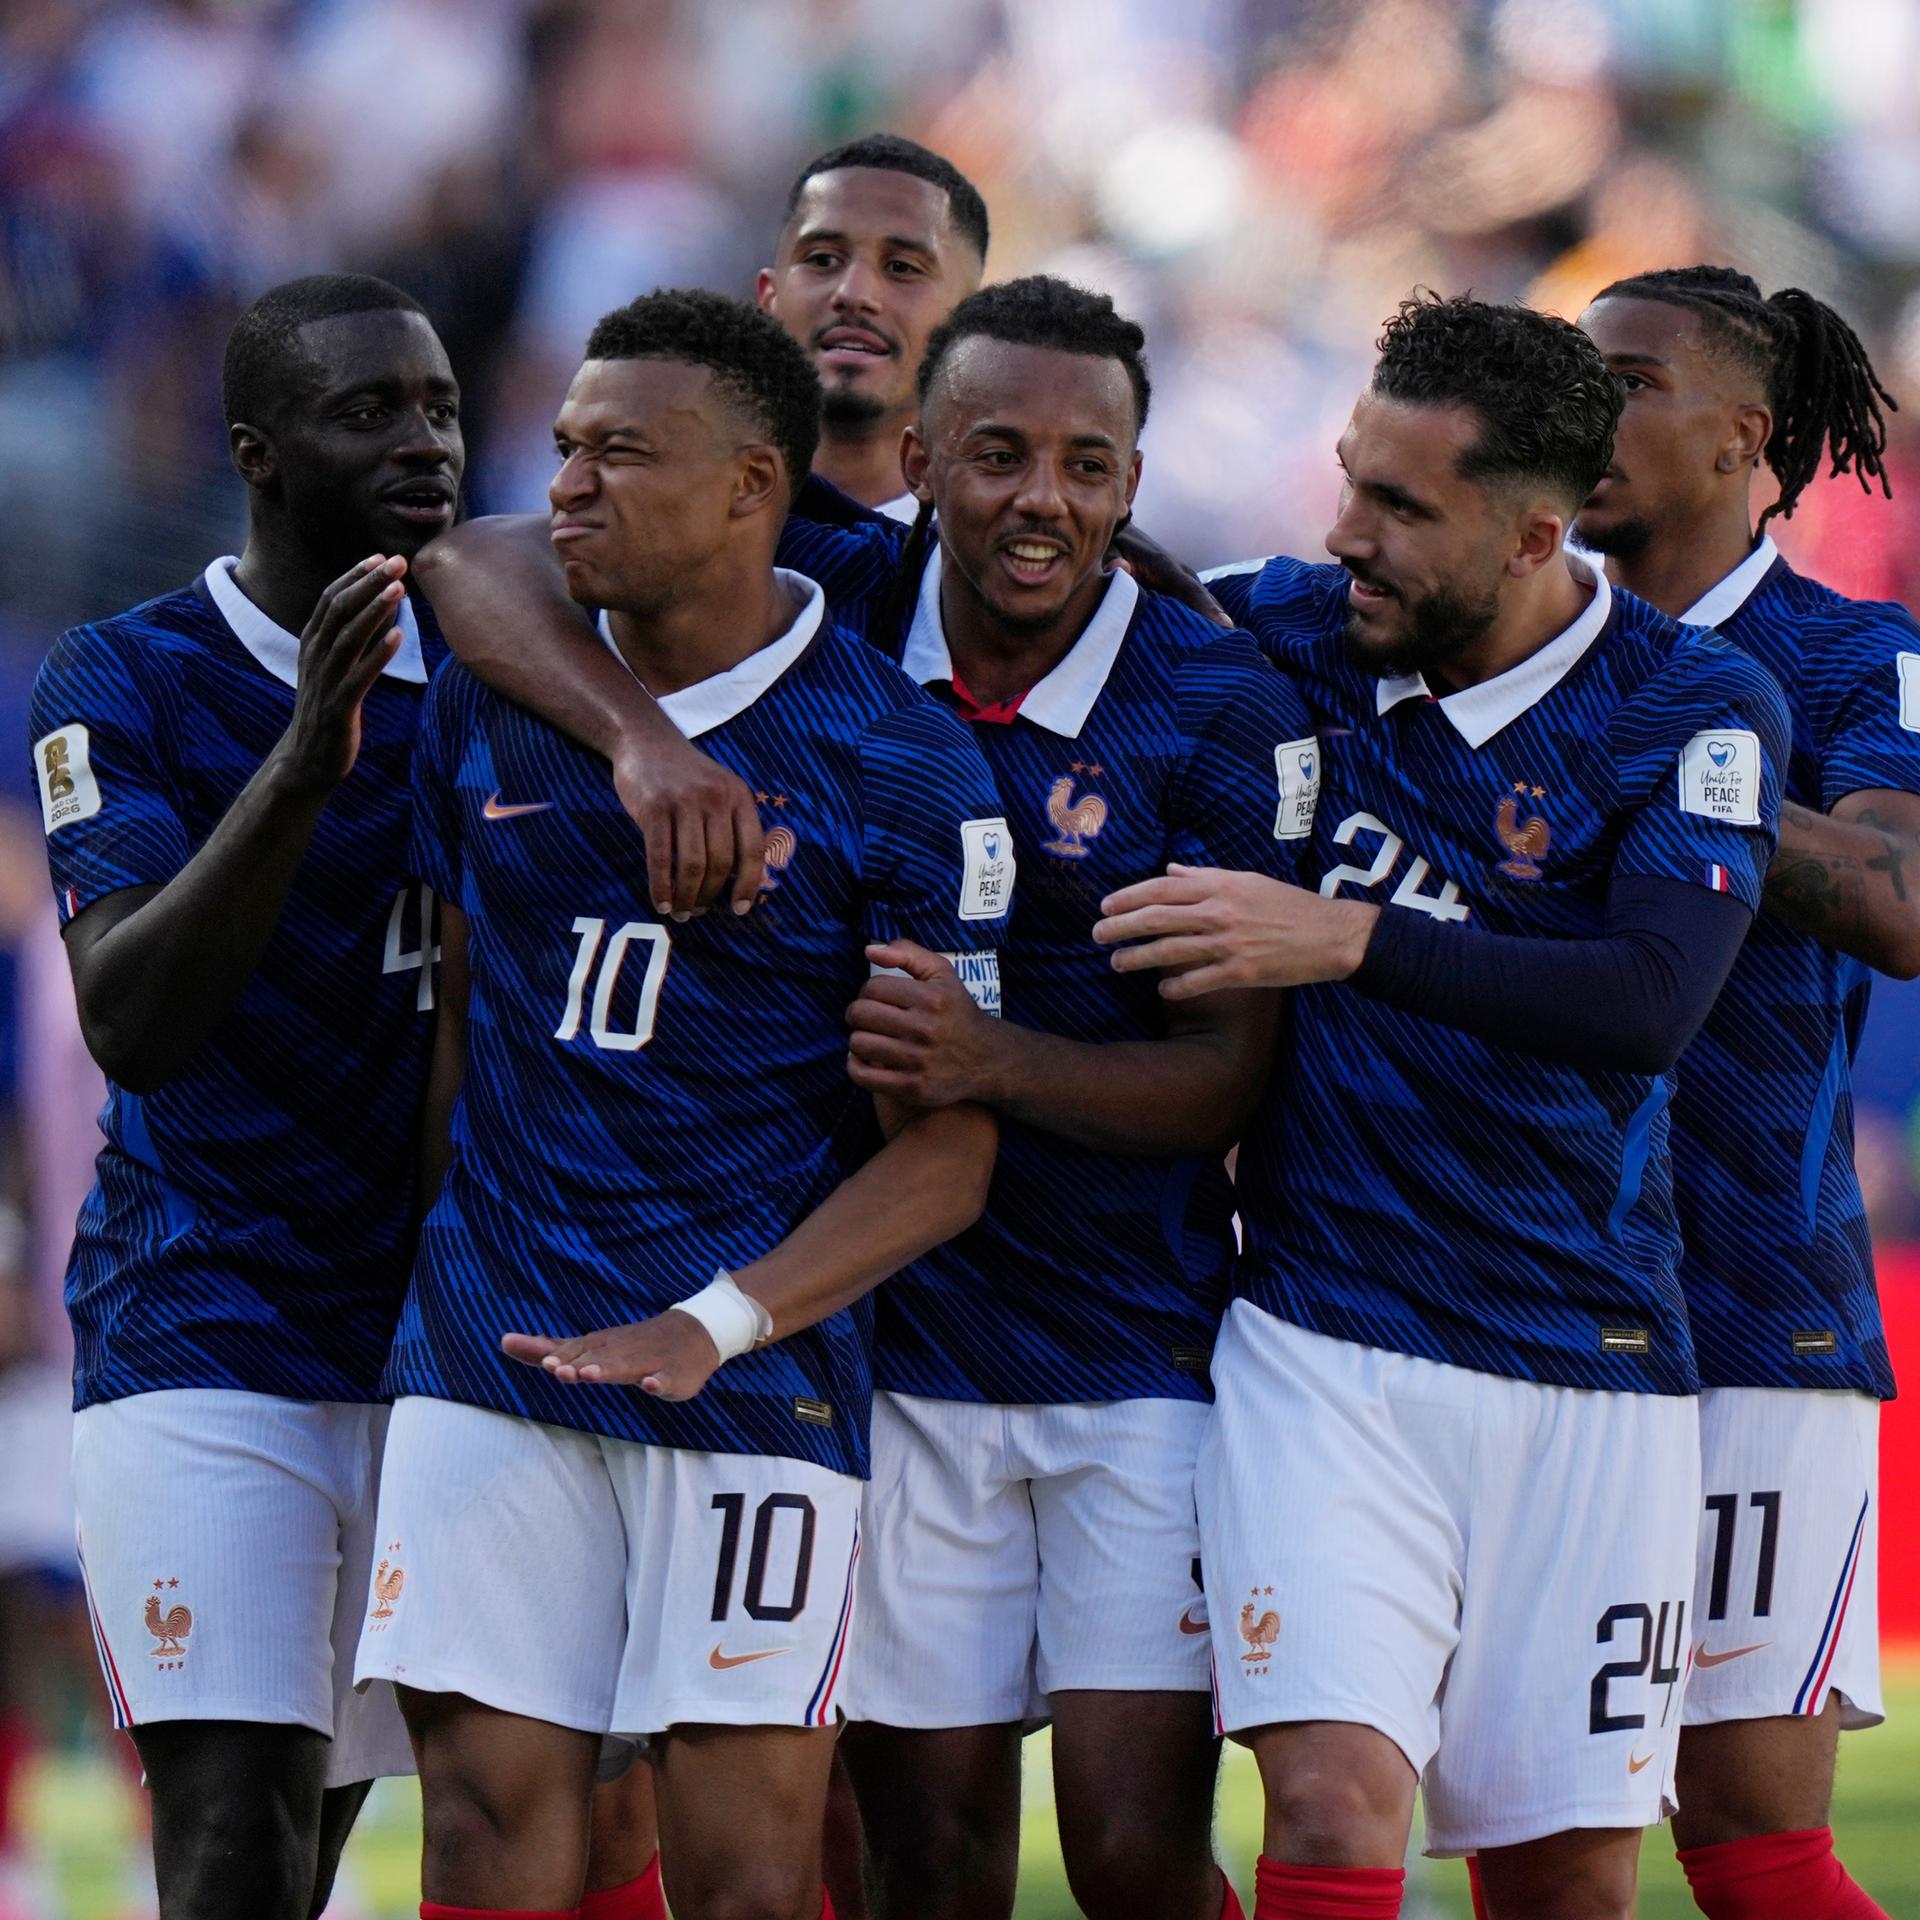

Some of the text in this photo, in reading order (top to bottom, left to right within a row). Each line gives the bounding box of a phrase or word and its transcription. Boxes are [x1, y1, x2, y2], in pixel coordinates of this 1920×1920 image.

[1296, 799, 1317, 817] PEAC
[1701, 769, 1743, 786] Unite For
[1704, 787, 1740, 804] PEACE
[1712, 805, 1733, 814] FIFA
[51, 804, 80, 822] 2026
[1319, 811, 1471, 922] 24
[382, 882, 441, 1012] 4
[554, 917, 672, 1051] 10
[711, 1493, 816, 1622] 10
[1705, 1491, 1781, 1621] 11
[158, 1661, 184, 1671] FFF
[1590, 1601, 1685, 1734] 24
